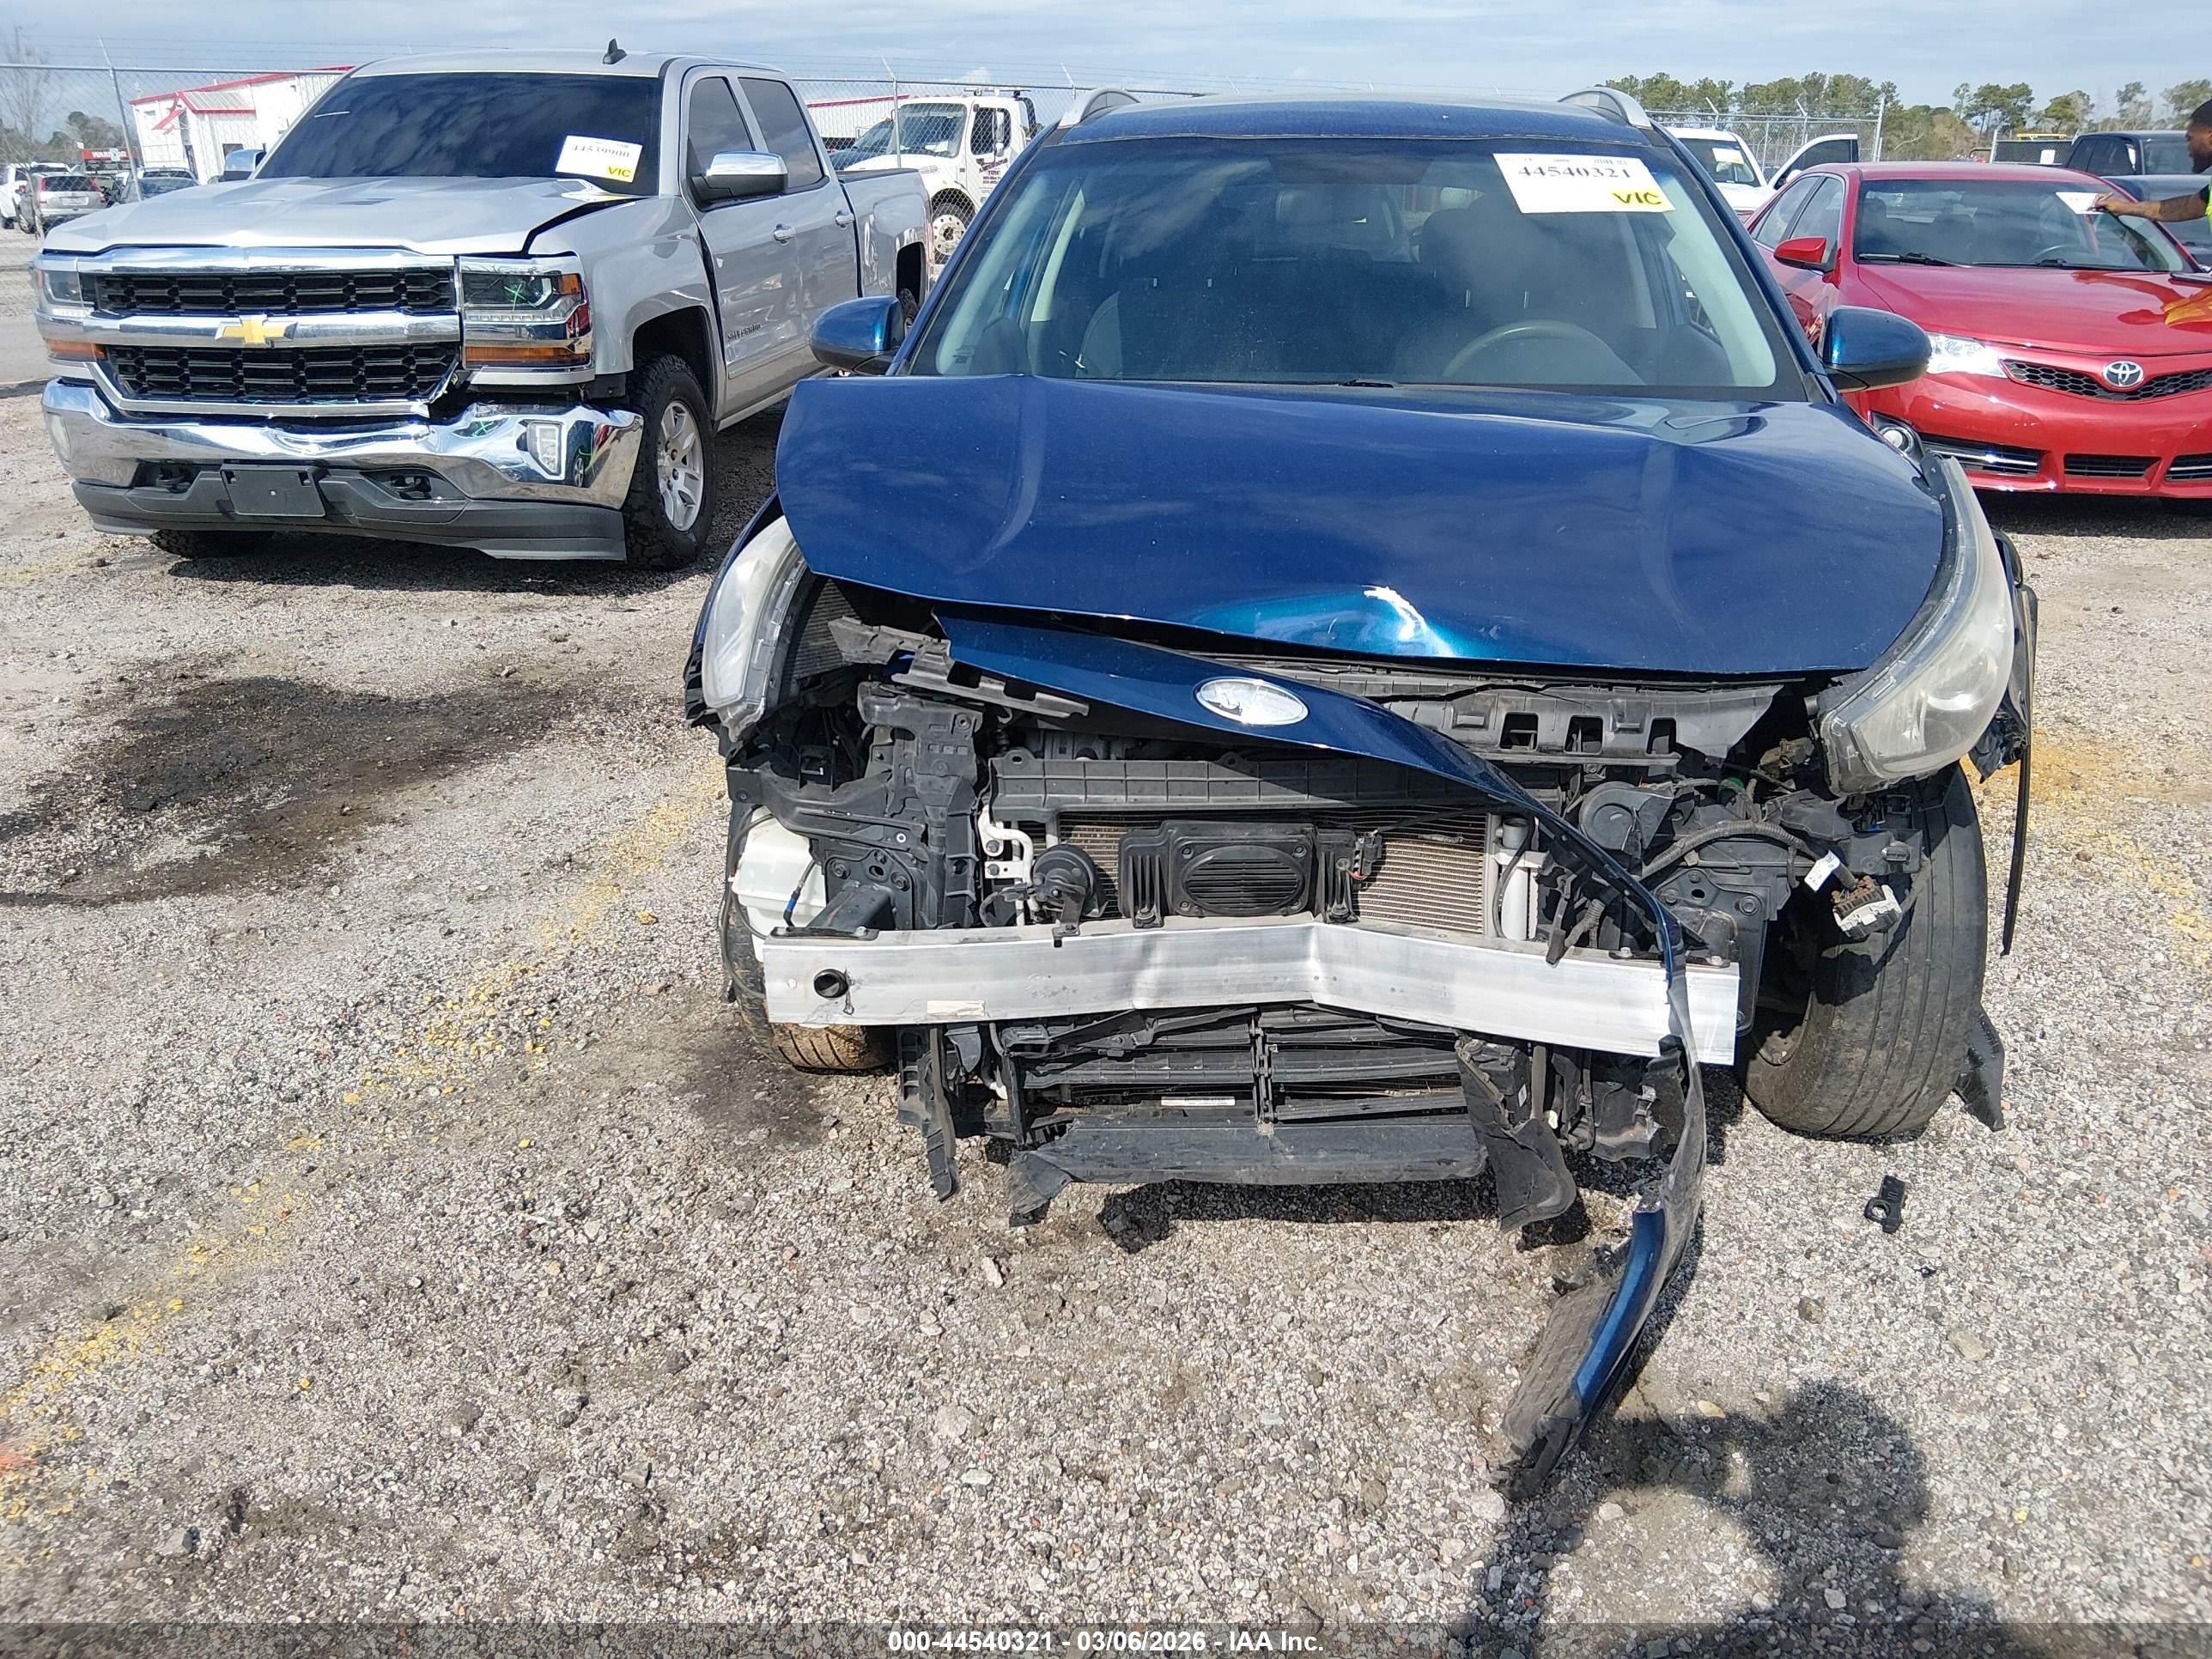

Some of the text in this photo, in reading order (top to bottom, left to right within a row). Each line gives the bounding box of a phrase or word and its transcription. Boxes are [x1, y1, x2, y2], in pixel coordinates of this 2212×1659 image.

[609, 166, 632, 178] VIC
[1518, 166, 1631, 179] 44540321
[1612, 191, 1662, 205] VIC
